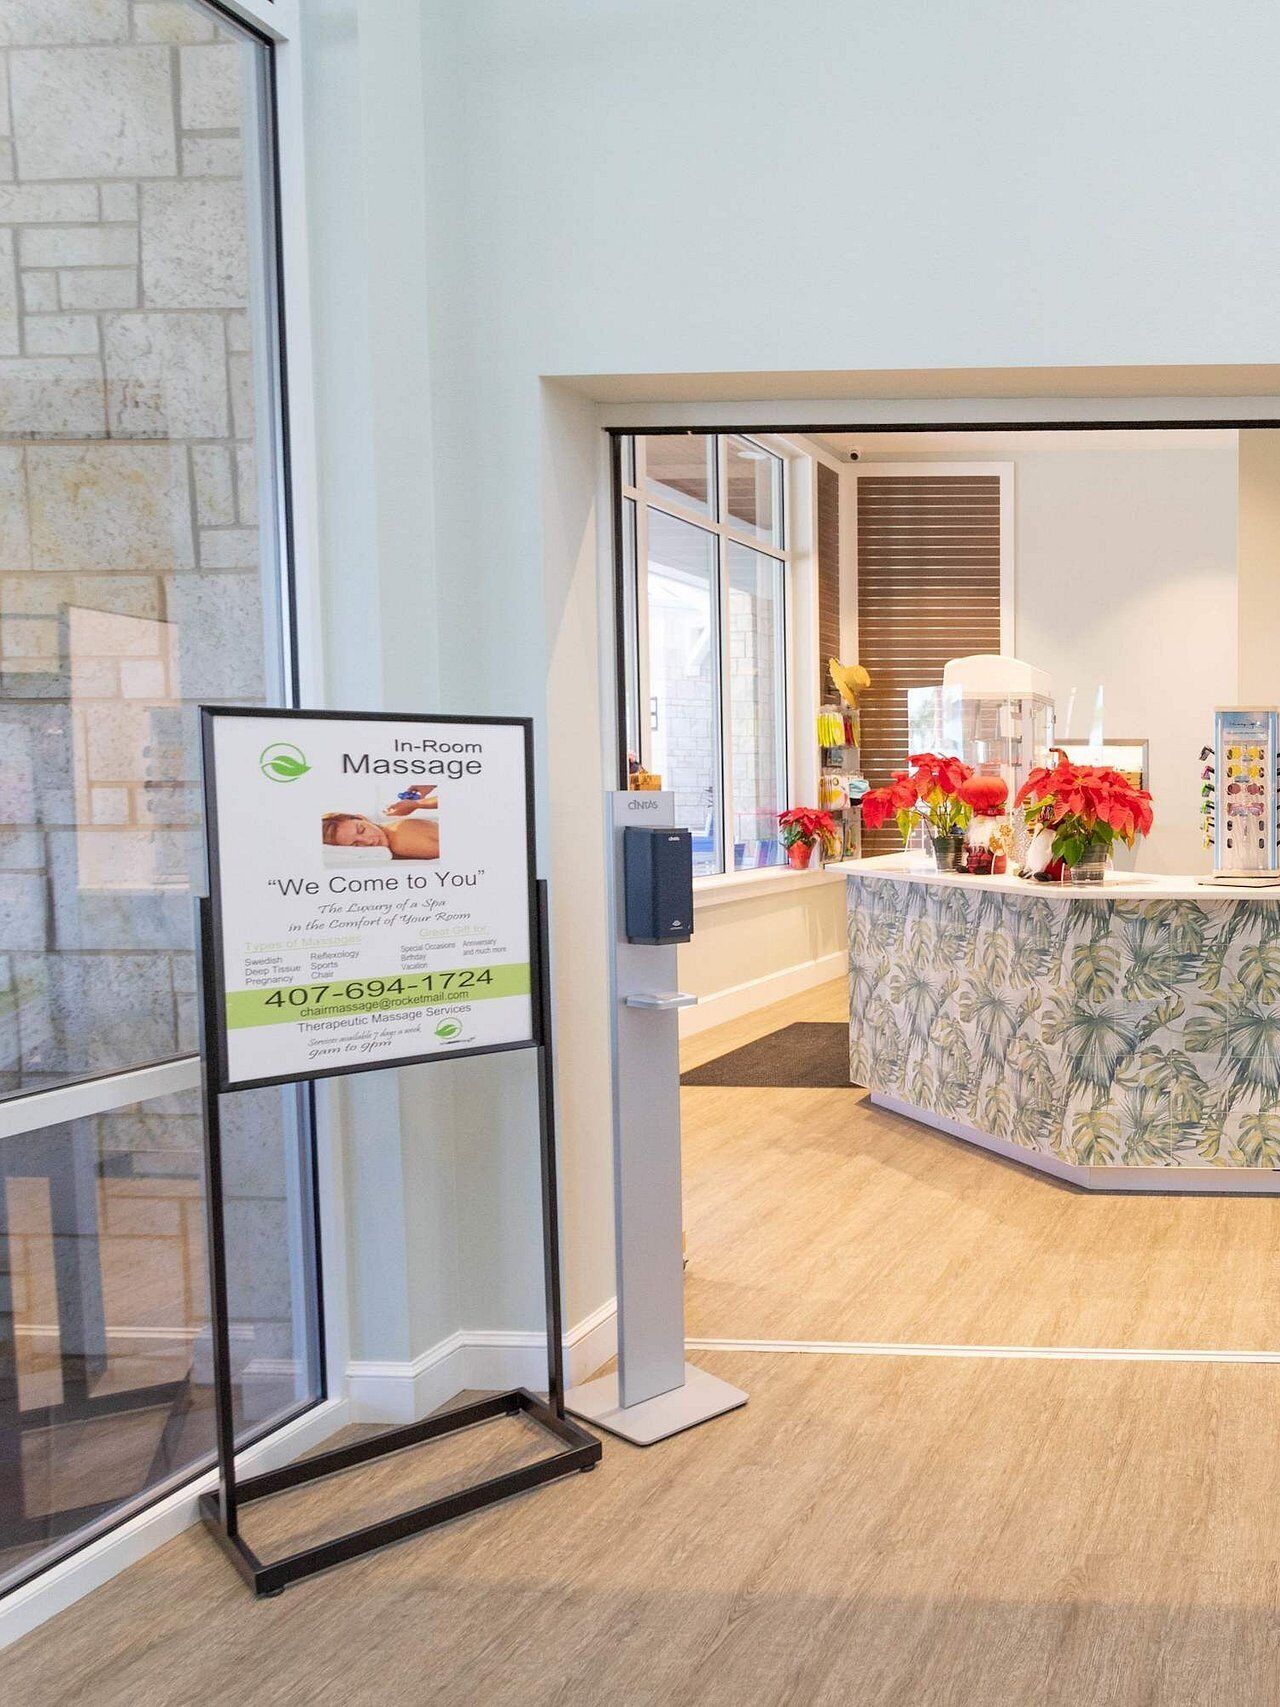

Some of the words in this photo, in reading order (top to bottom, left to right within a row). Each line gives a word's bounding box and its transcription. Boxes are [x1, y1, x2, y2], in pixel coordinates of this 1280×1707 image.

[394, 738, 483, 754] In-Room
[342, 752, 483, 779] Massage
[329, 876, 399, 894] Come
[407, 874, 427, 889] to
[318, 902, 343, 916] The
[346, 901, 393, 915] Luxury
[396, 898, 411, 912] of
[410, 900, 418, 908] a
[422, 897, 447, 911] Spa
[288, 923, 301, 933] in
[305, 919, 325, 931] the
[328, 916, 382, 931] Comfort
[384, 914, 398, 927] of
[400, 913, 432, 925] Your
[434, 911, 471, 922] Room
[425, 941, 456, 951] Occasions
[245, 956, 283, 967] Swedish
[310, 950, 360, 961] Reflexology
[245, 966, 270, 978] Deep
[272, 964, 302, 974] Tissue
[310, 961, 339, 971] Sports
[401, 962, 428, 971] Vacation
[245, 975, 294, 986] Pregnancy
[310, 971, 335, 980] Chair
[264, 969, 494, 1009] 407-694-1724
[300, 989, 470, 1018] chairmassage@rocketmail.com
[297, 1015, 369, 1034] Therapeutic
[371, 1009, 424, 1025] Massage
[425, 1003, 472, 1018] Services
[344, 1043, 357, 1052] to
